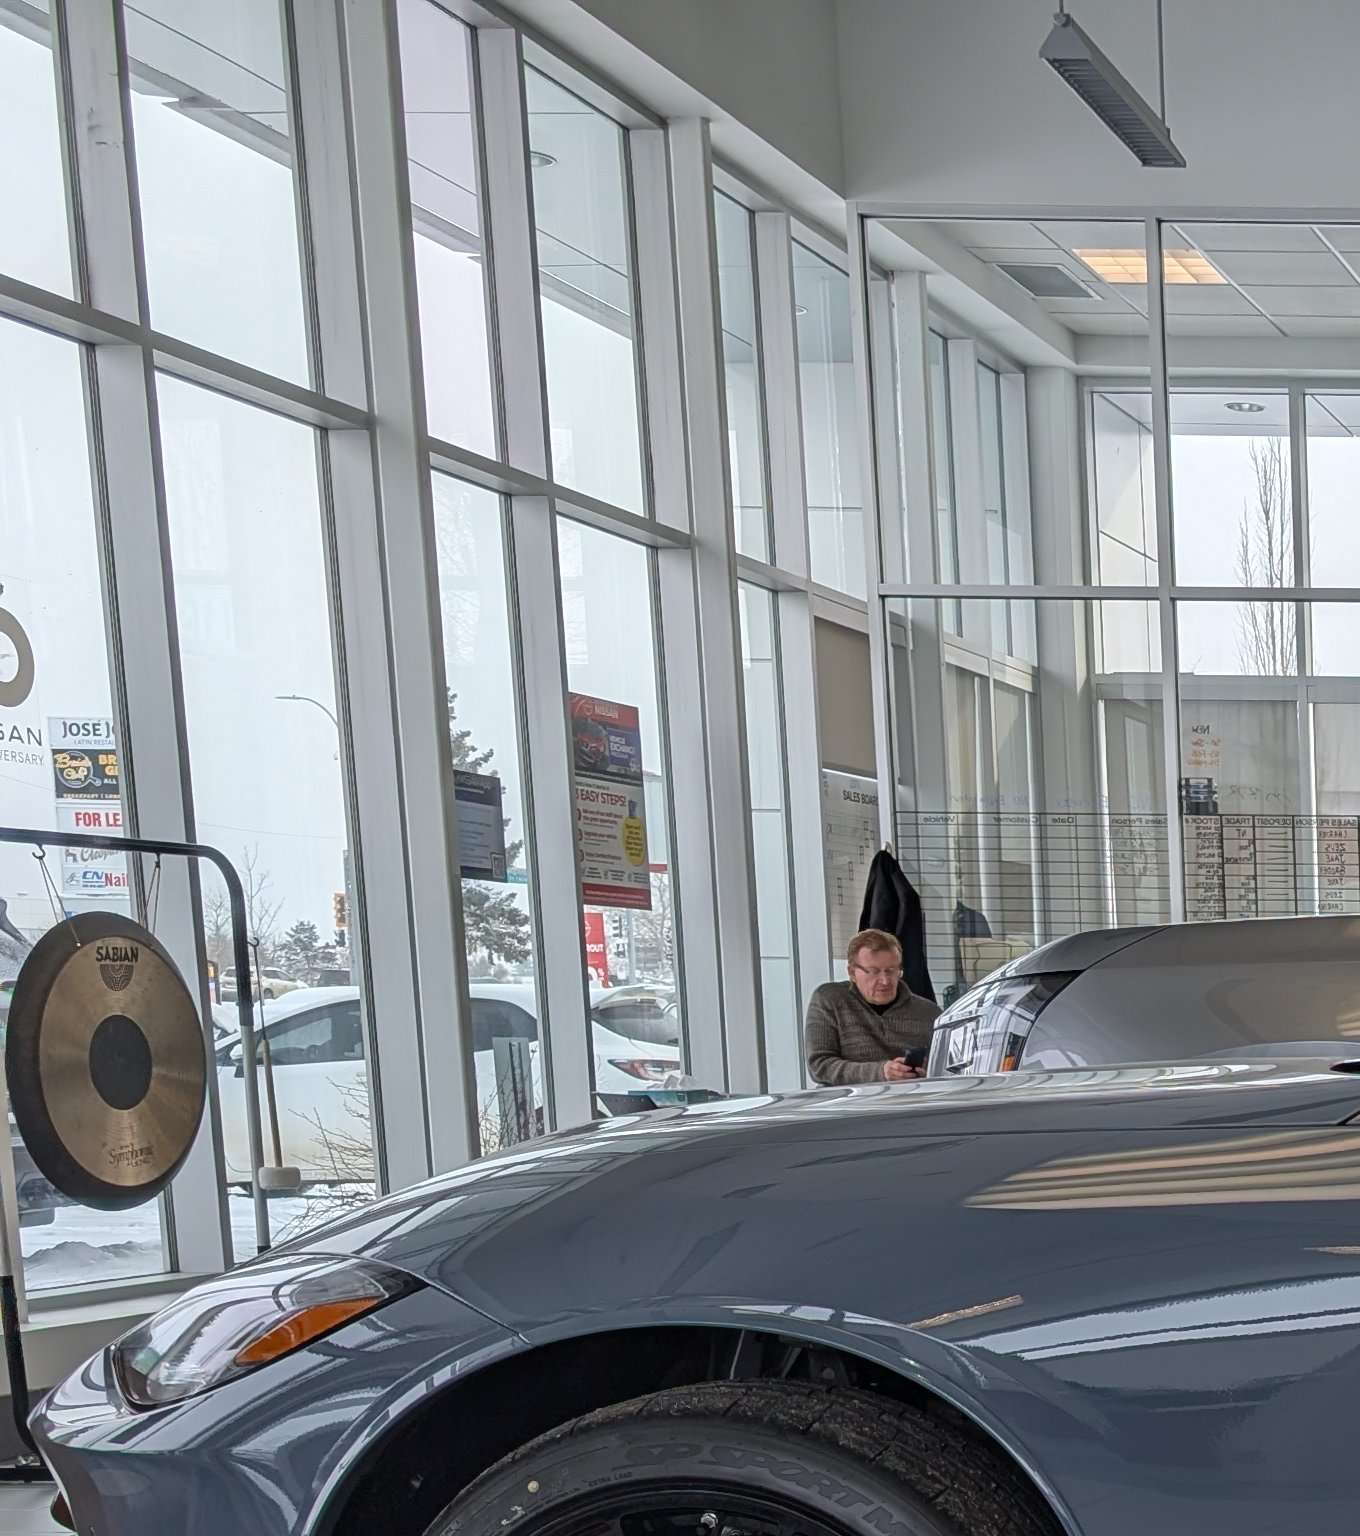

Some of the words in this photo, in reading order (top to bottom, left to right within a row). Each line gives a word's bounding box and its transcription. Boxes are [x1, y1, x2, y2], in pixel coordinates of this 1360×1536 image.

[580, 788, 599, 802] EASY
[75, 812, 101, 827] FOR
[96, 946, 139, 963] SABIAN
